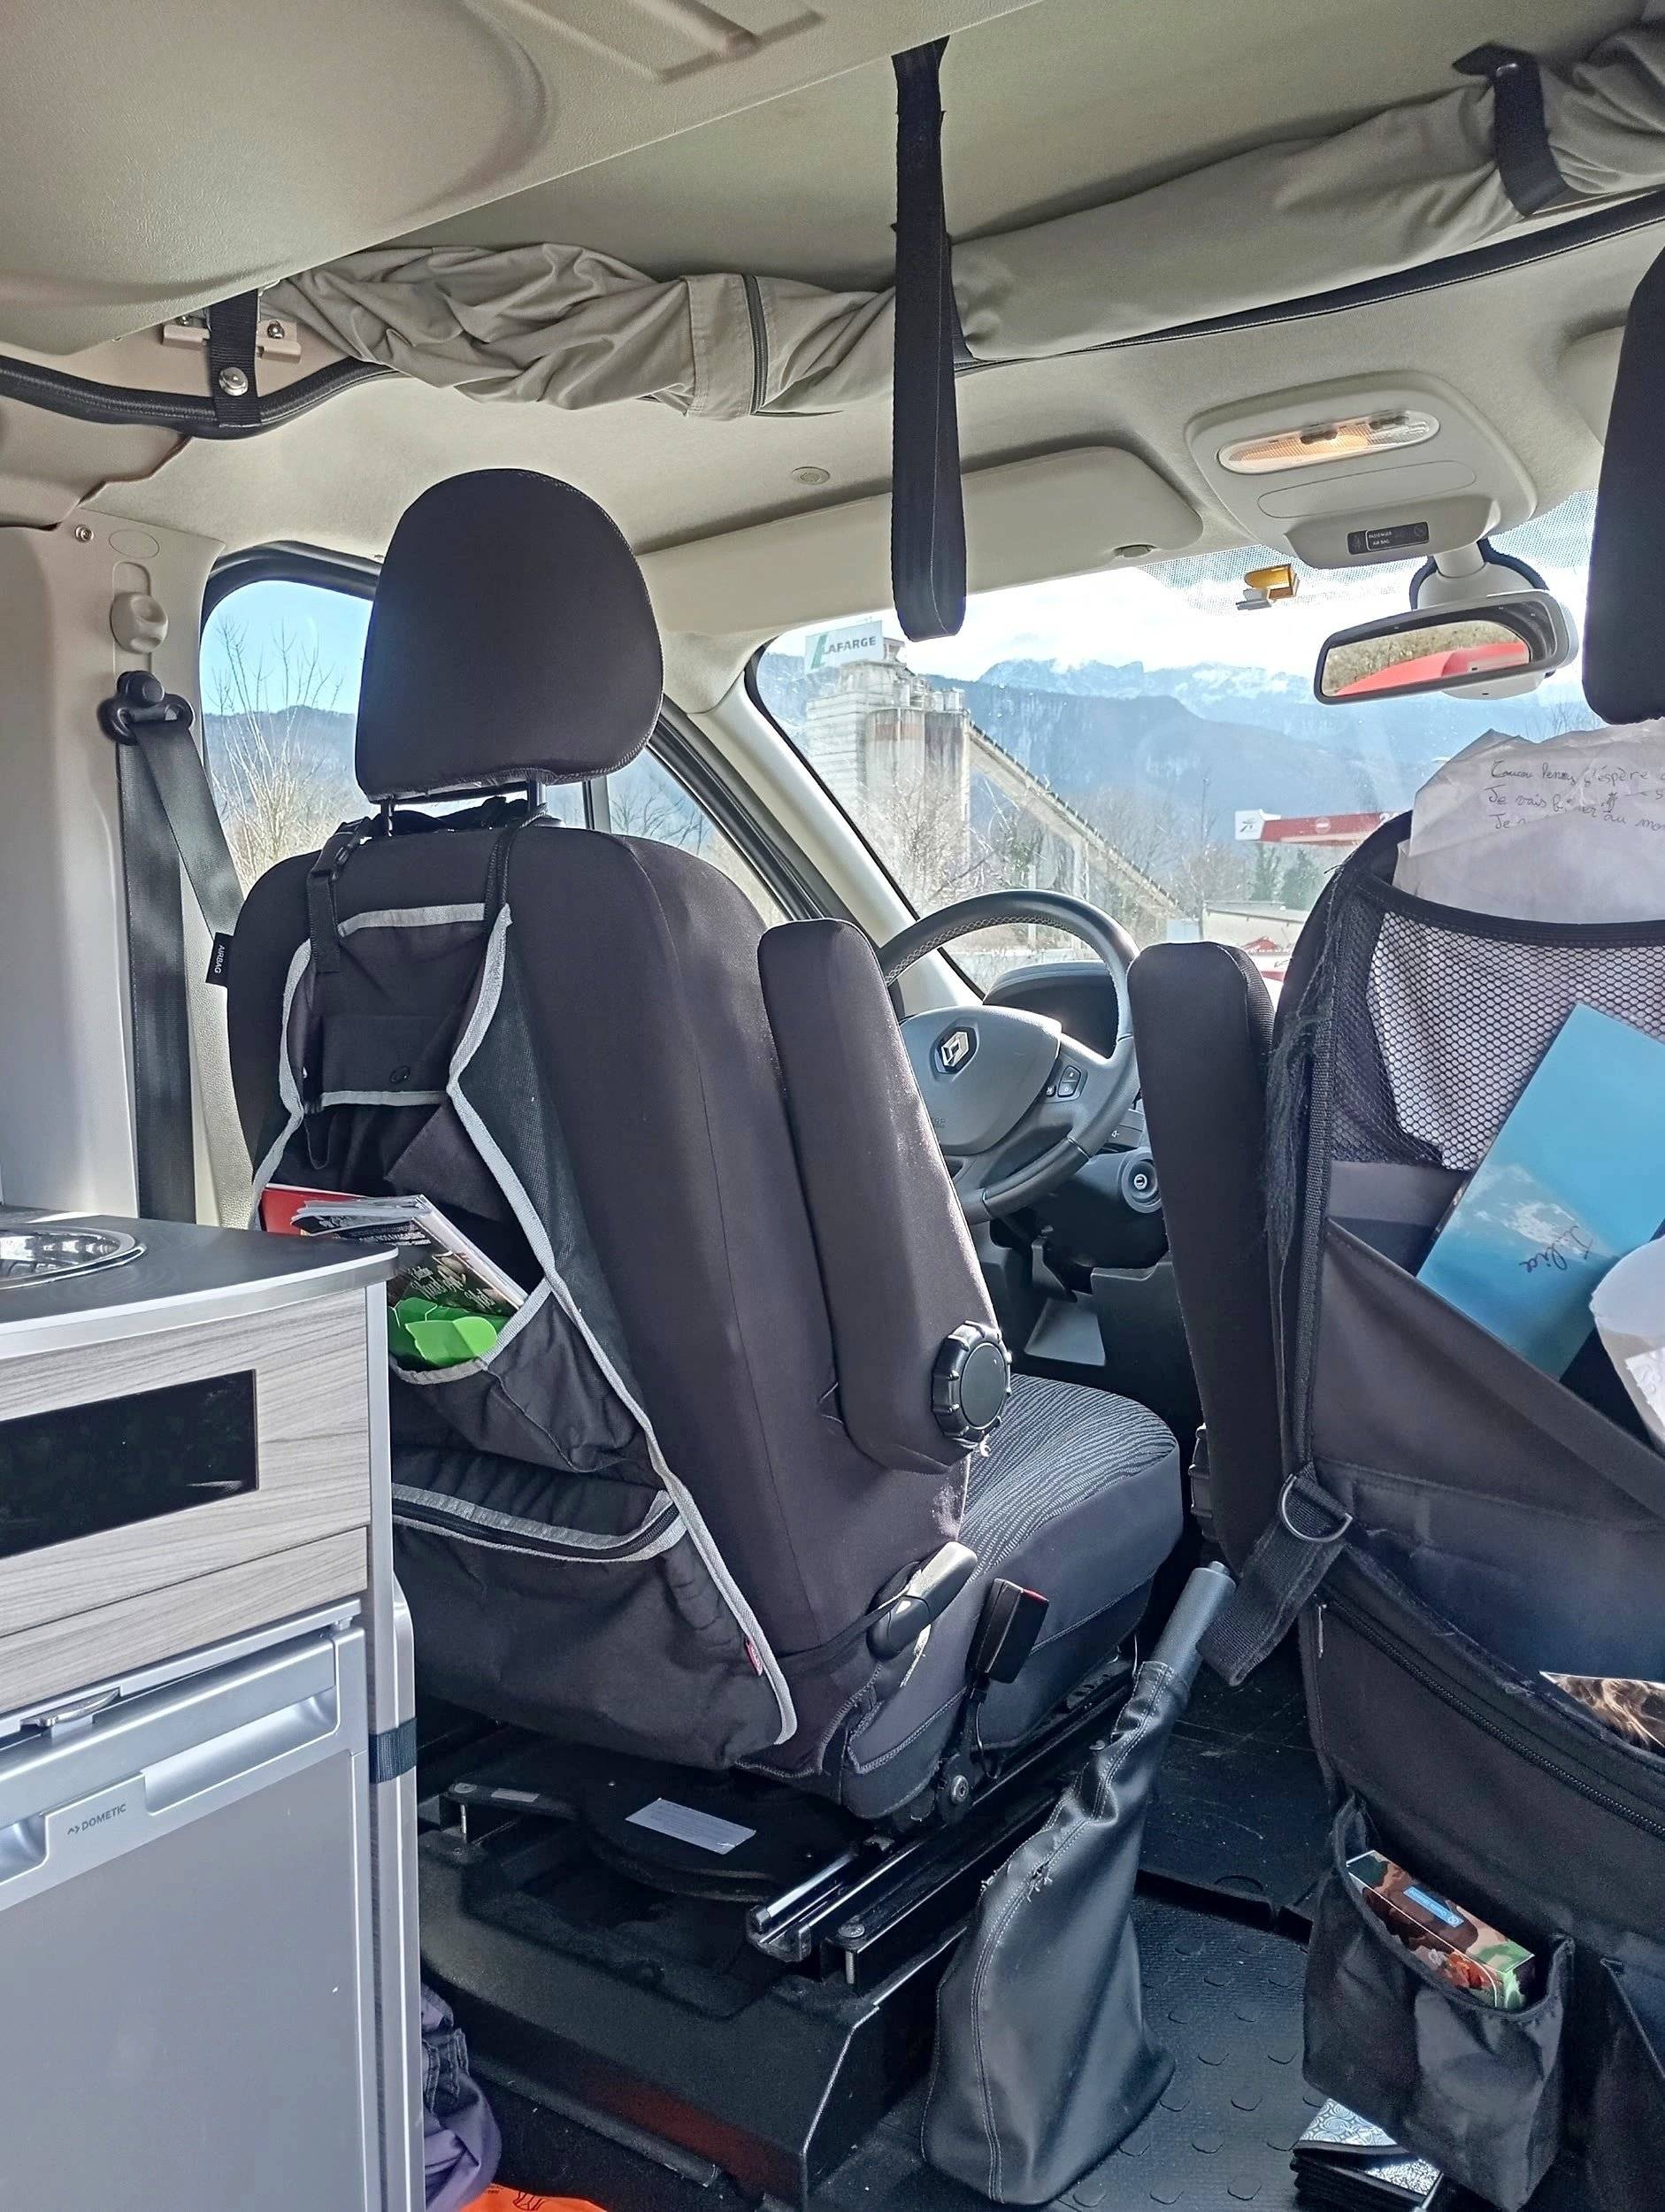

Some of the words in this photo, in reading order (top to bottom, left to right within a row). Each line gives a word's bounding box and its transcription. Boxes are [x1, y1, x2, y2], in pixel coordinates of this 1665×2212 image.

[812, 634, 877, 667] LAFARGE
[214, 944, 226, 974] AIRBAG
[81, 1803, 127, 1832] DOMETIC
